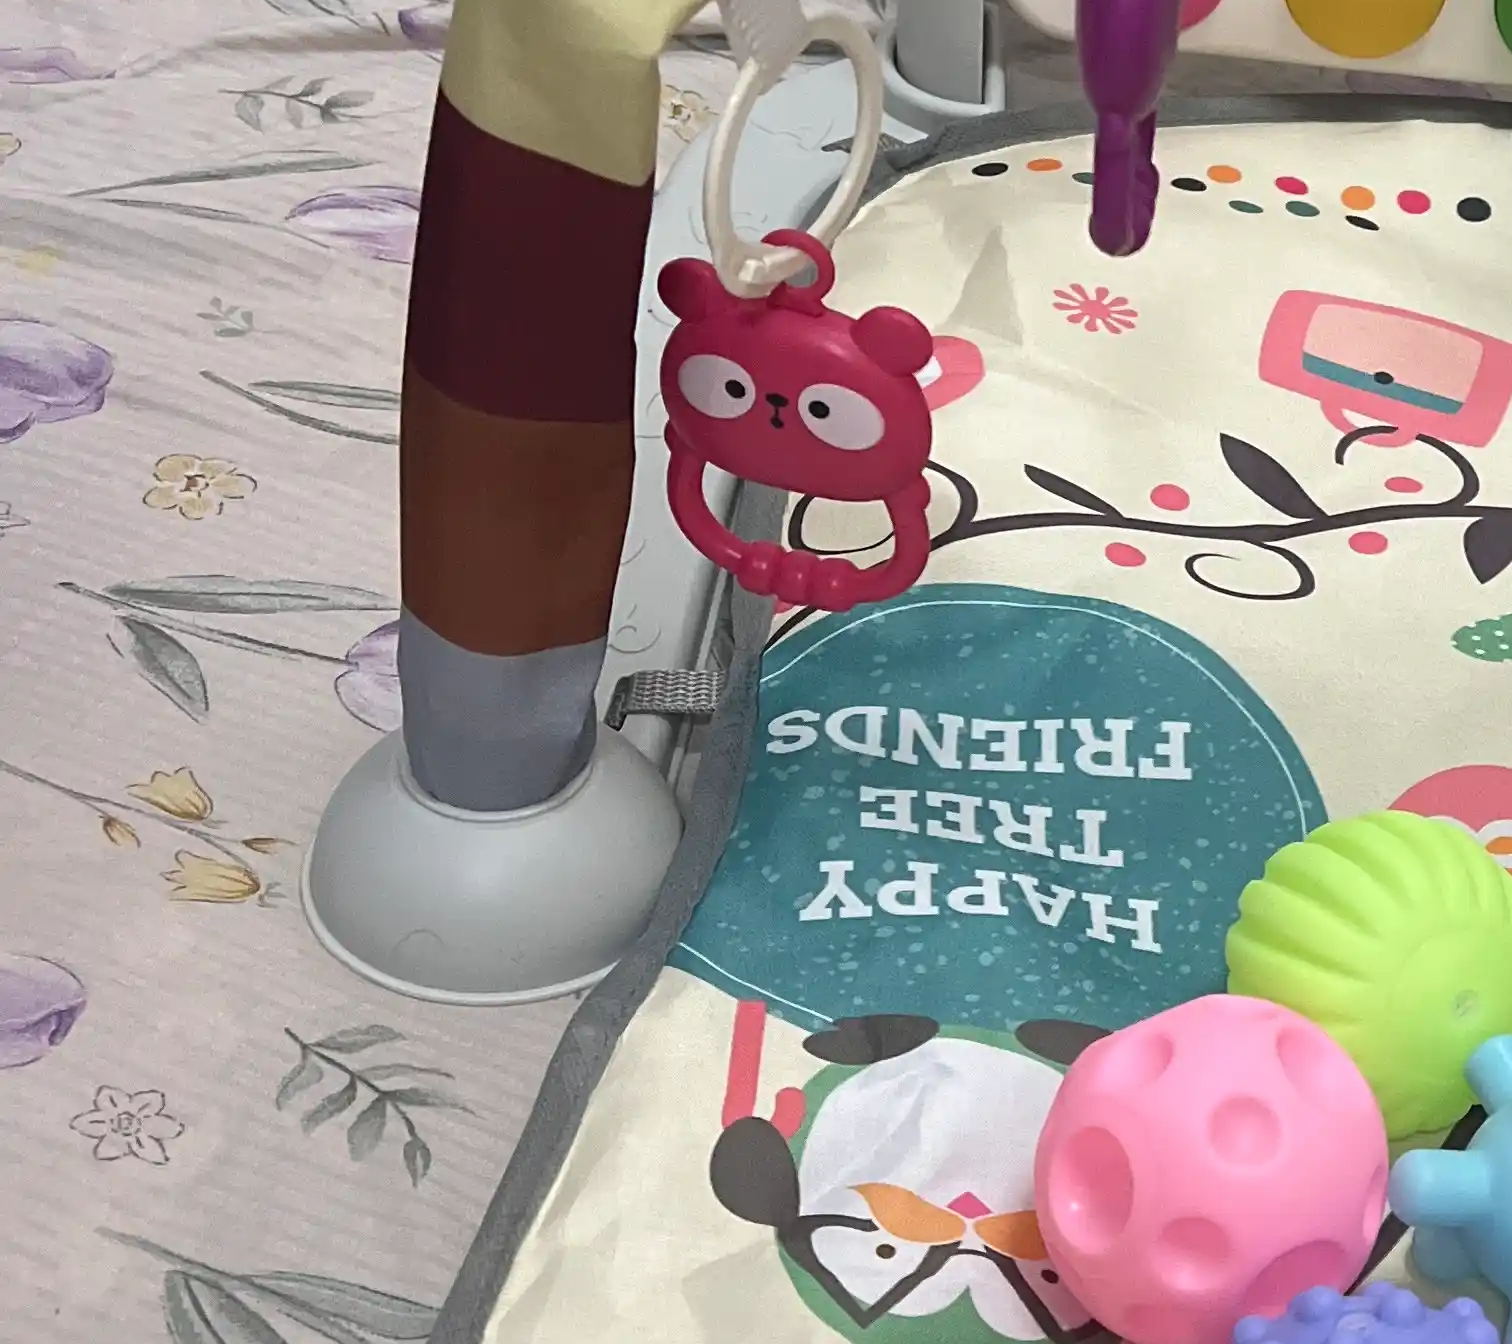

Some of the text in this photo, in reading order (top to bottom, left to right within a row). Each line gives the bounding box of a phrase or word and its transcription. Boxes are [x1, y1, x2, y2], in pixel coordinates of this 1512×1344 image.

[766, 704, 1192, 780] FRIENDS
[860, 785, 1124, 867] TREE
[798, 859, 1163, 953] HAPPY
